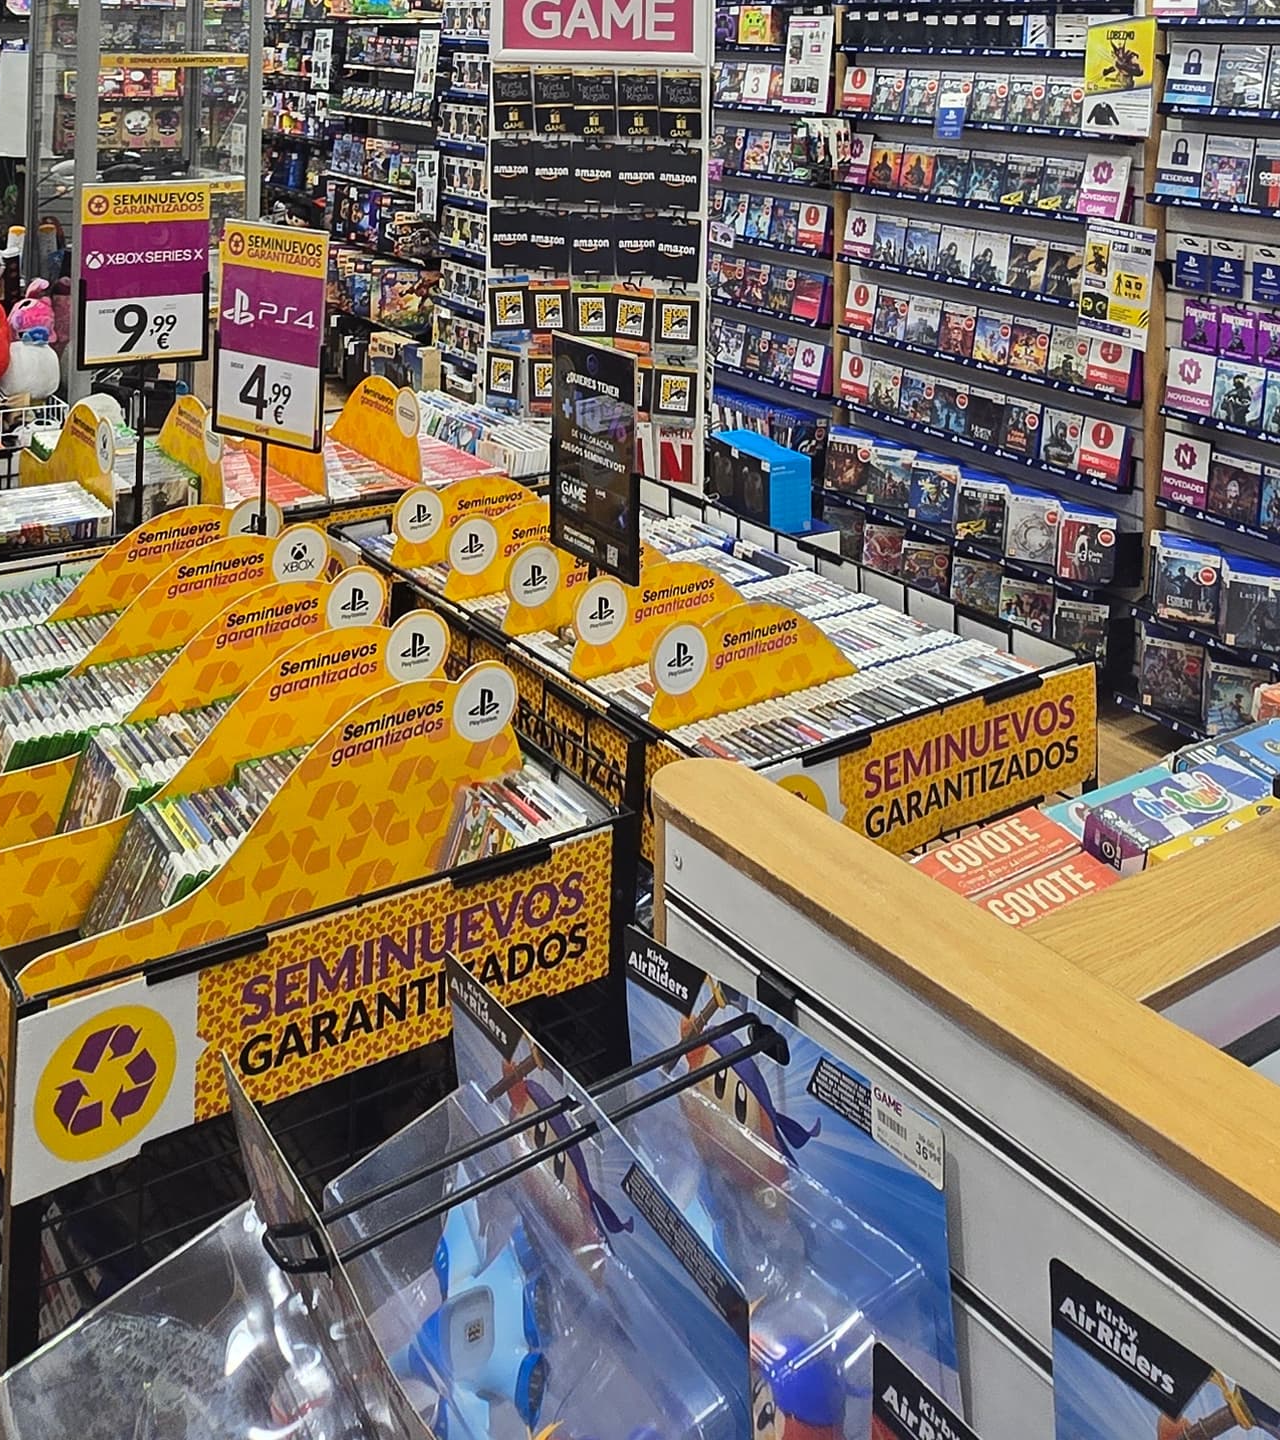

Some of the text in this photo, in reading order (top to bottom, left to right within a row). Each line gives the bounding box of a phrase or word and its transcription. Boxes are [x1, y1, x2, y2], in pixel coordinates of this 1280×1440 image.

[1107, 30, 1135, 40] LOBEZNO
[1172, 83, 1207, 93] RESERVAS
[503, 120, 524, 129] GAME
[545, 123, 566, 132] GAME
[494, 165, 528, 176] amazon
[535, 167, 568, 177] amazon
[575, 170, 611, 179] amazon
[619, 172, 655, 181] amazon
[1162, 173, 1193, 184] RESERVAS
[113, 192, 204, 205] SEMINUEVOS
[113, 202, 204, 215] GARANTIZADOS
[107, 249, 204, 265] XBOX SERIES X
[248, 235, 322, 256] SEMINUEVOS
[247, 247, 322, 269] GARANTIZADOS
[259, 302, 314, 329] PS4
[1186, 306, 1216, 323] FORTNITE
[1222, 313, 1253, 329] FORTNITE
[565, 372, 620, 398] ¿QUIERES TENER
[659, 427, 693, 441] NETFLIX
[561, 481, 586, 504] GAME
[1172, 492, 1195, 504] GAME
[137, 520, 220, 545] Seminuevos
[177, 552, 264, 579] Seminuevos
[282, 559, 314, 573] XBOX
[168, 566, 264, 598] garantizados
[226, 597, 318, 628] Seminuevos
[216, 611, 318, 649] garantizados
[280, 642, 377, 677] Seminuevos
[269, 659, 378, 702] garantizados
[343, 699, 444, 742] Seminuevos
[331, 716, 443, 767] garantizados
[864, 695, 1076, 799] SEMINUEVOS
[865, 735, 1079, 838] GARANTIZADOS
[935, 817, 1041, 874] COYOTE
[987, 863, 1096, 926] COYOTE
[240, 872, 585, 1028] SEMINUEVOS
[647, 948, 669, 969] Kirby
[238, 926, 588, 1077] GARANTIADOS
[467, 981, 488, 1008] Kirby
[873, 1087, 902, 1116] GAME
[1095, 1300, 1138, 1342] Kirby
